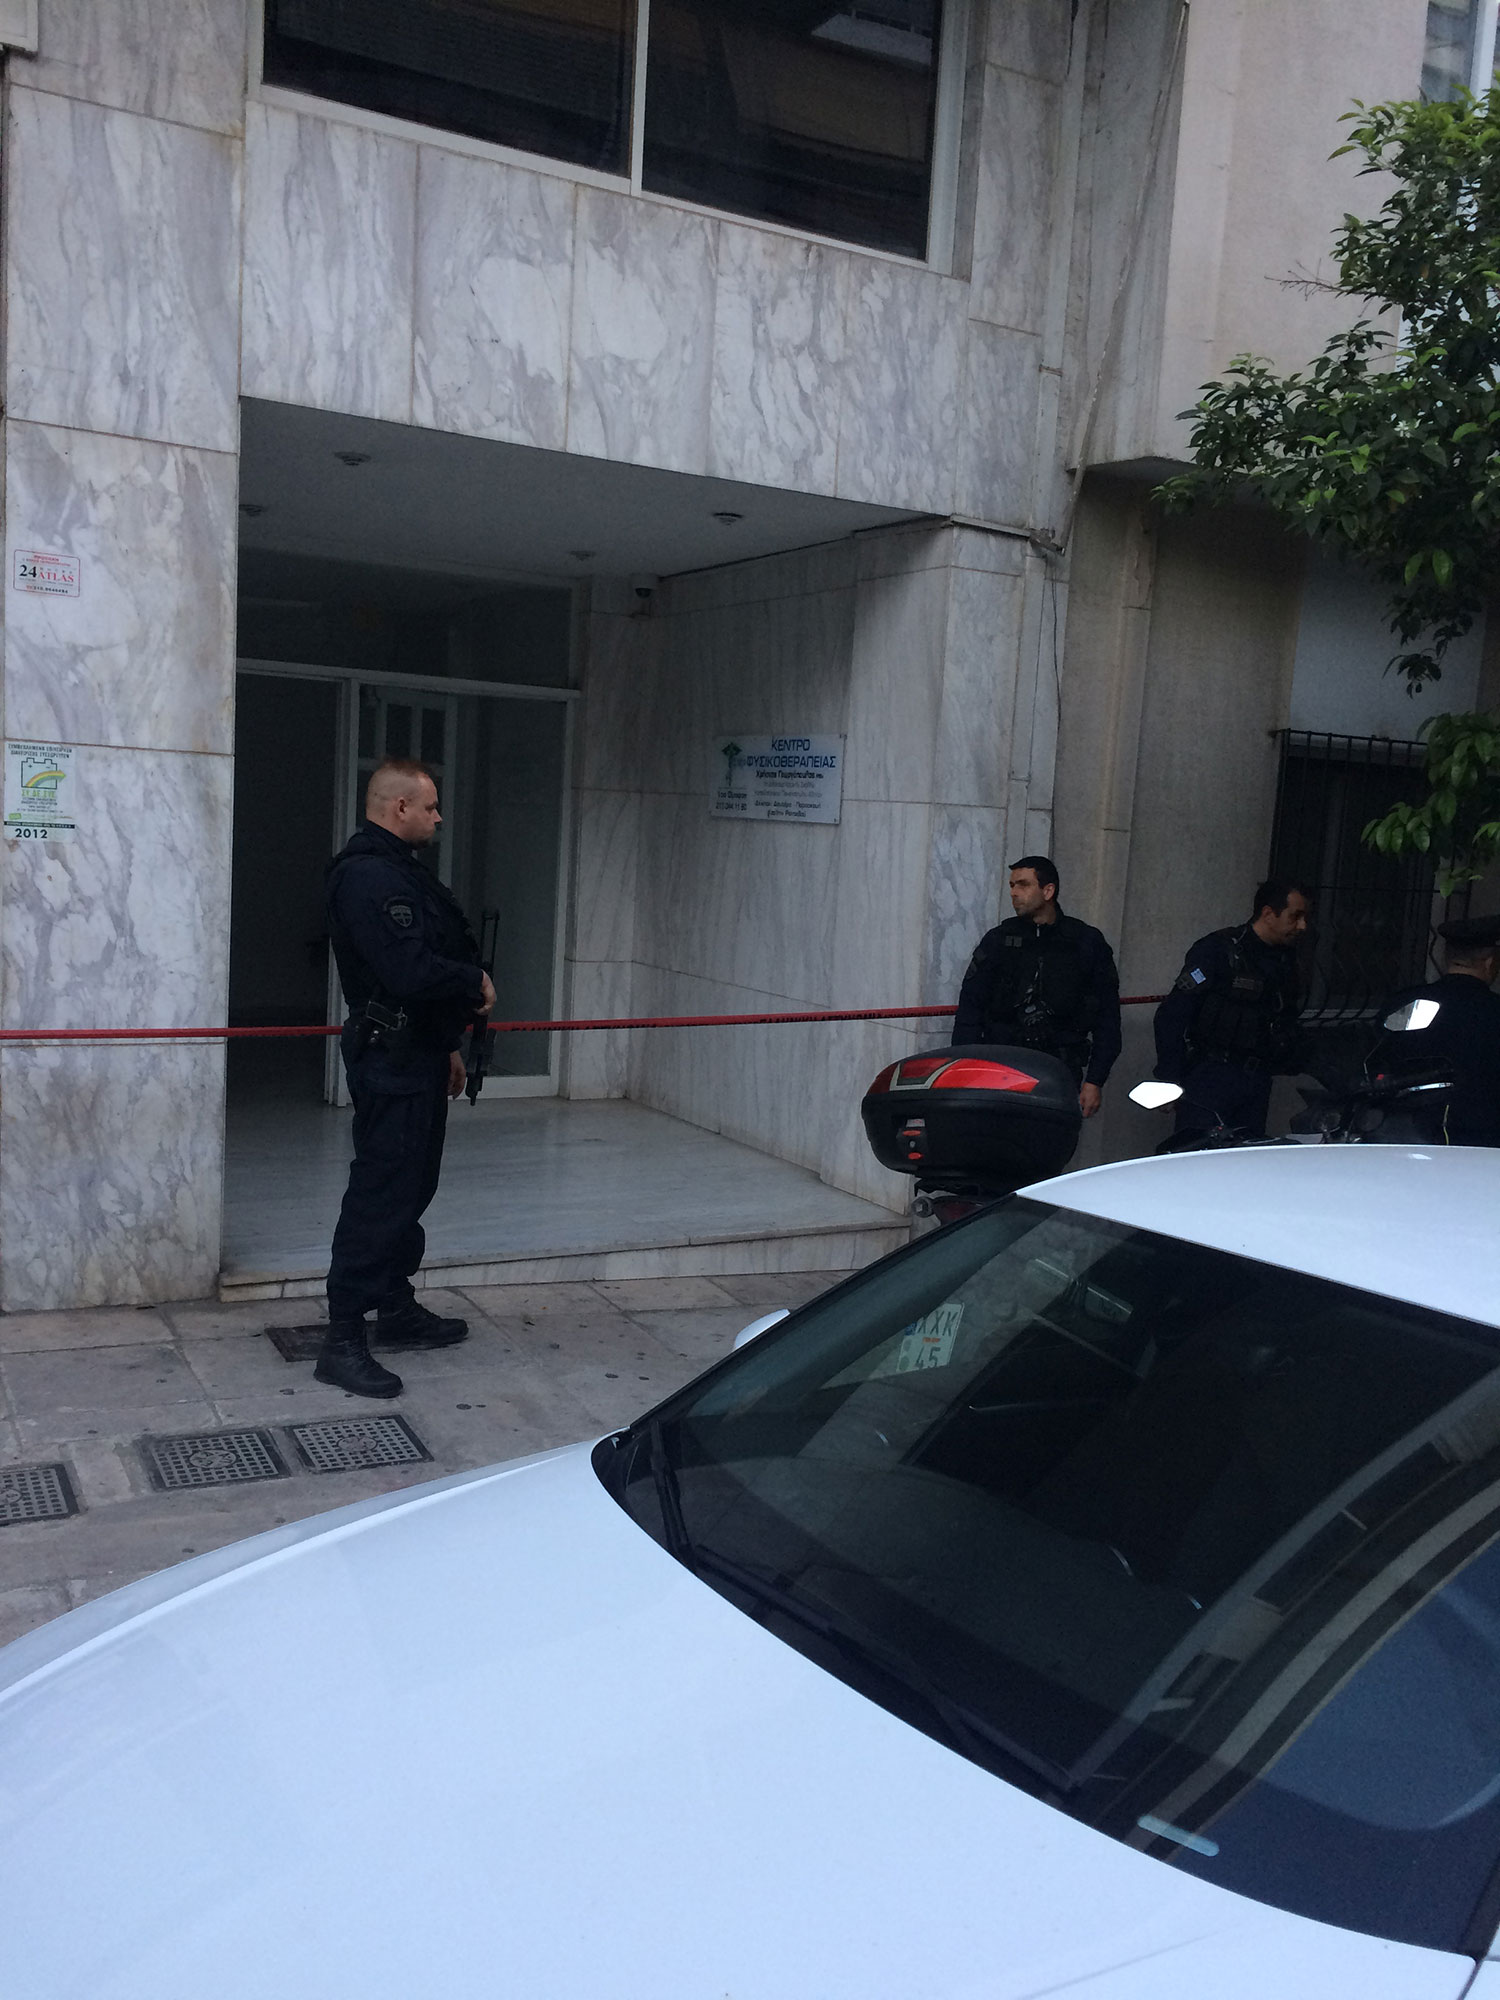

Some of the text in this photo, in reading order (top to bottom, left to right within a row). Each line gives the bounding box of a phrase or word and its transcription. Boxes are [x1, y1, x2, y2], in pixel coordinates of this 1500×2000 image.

[19, 564, 37, 578] 24
[39, 571, 74, 582] ATLAS
[771, 738, 811, 752] ΚΕΝΤΡΟ
[746, 755, 837, 769] ΦΥΣΙΚΟΘΕΡΑΠΕΙΑΣ
[15, 827, 48, 839] 2012
